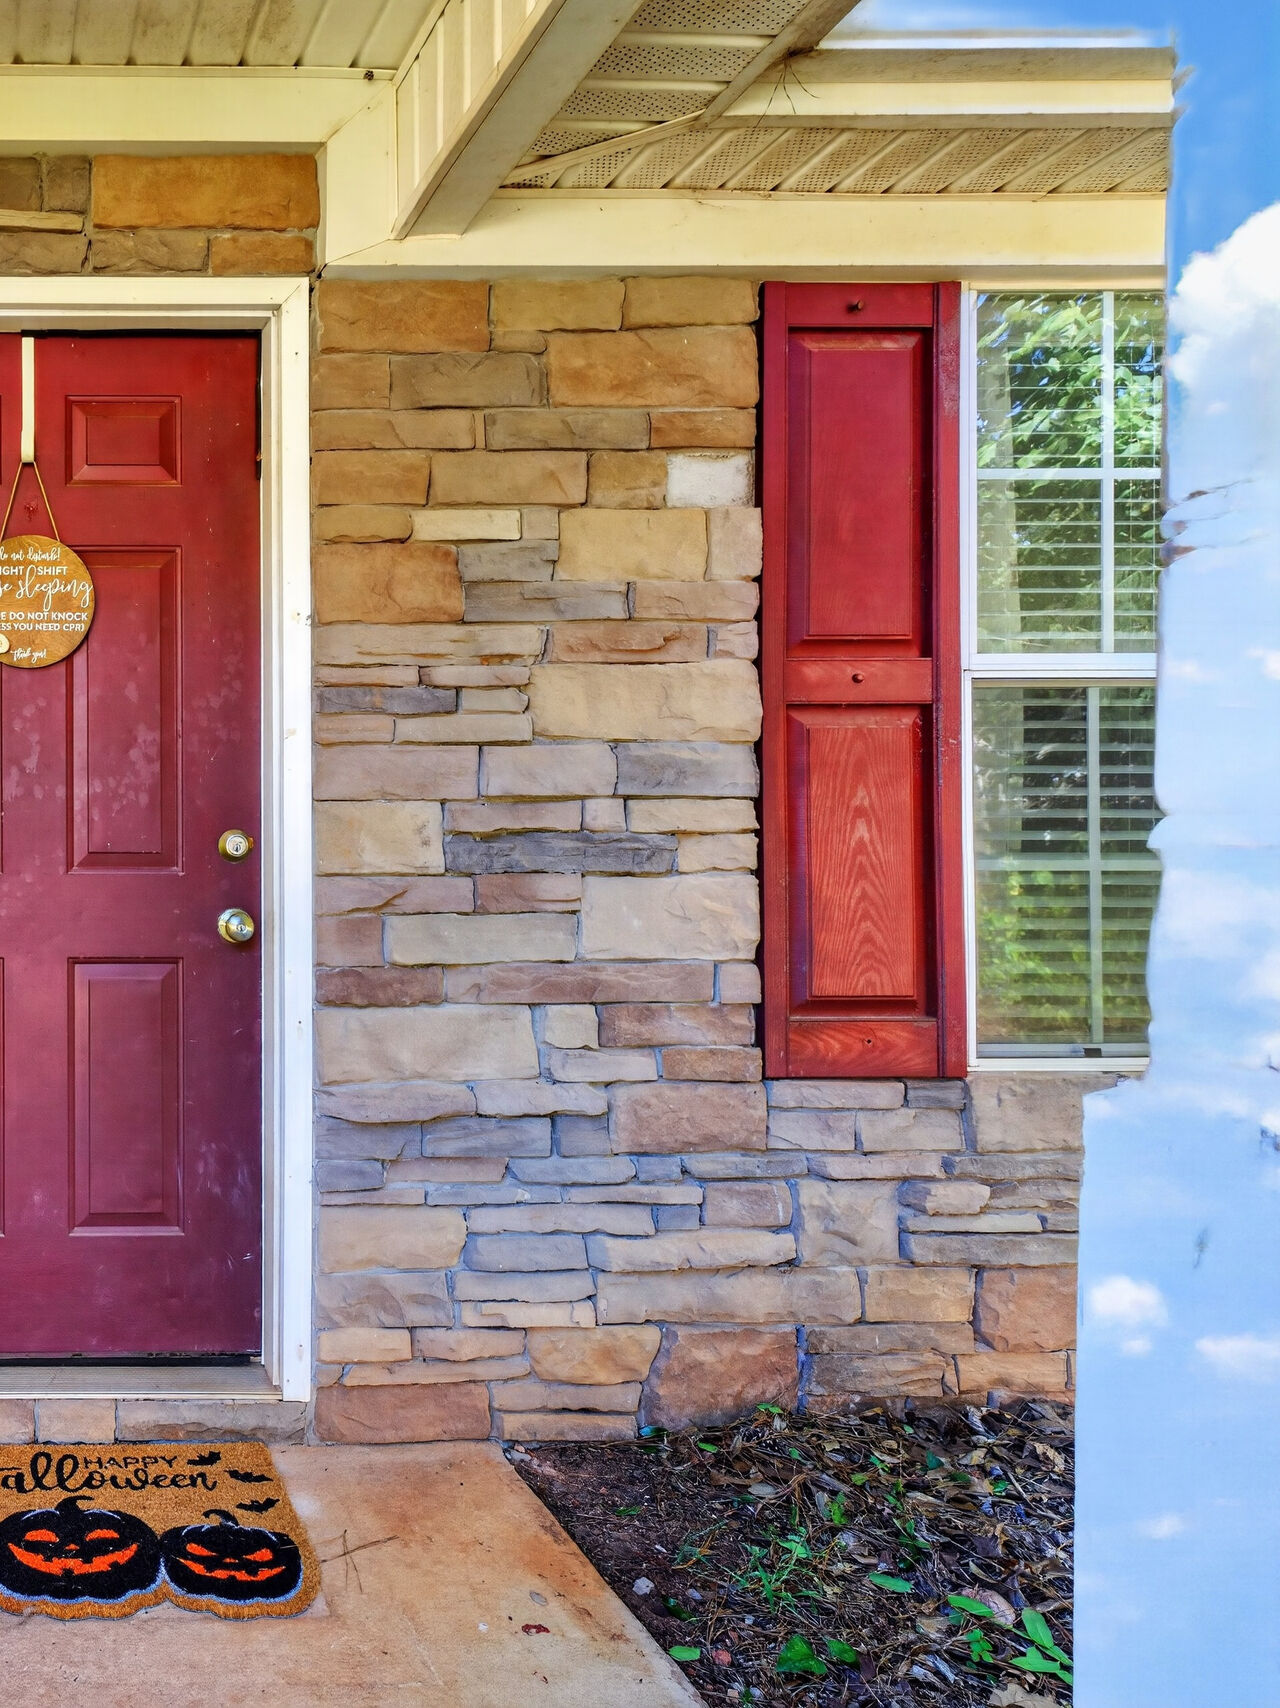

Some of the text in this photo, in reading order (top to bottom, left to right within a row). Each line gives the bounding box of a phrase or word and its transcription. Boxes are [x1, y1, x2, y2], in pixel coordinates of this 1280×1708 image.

[11, 549, 24, 561] not
[37, 566, 68, 576] SHIFT
[16, 565, 94, 611] sleeping
[9, 611, 25, 620] DO
[27, 611, 49, 621] NOT
[51, 612, 88, 621] KNOCK
[14, 623, 33, 631] YOU
[36, 623, 60, 631] NEED
[62, 623, 85, 632] CPR)
[83, 1455, 178, 1470] HAPPY
